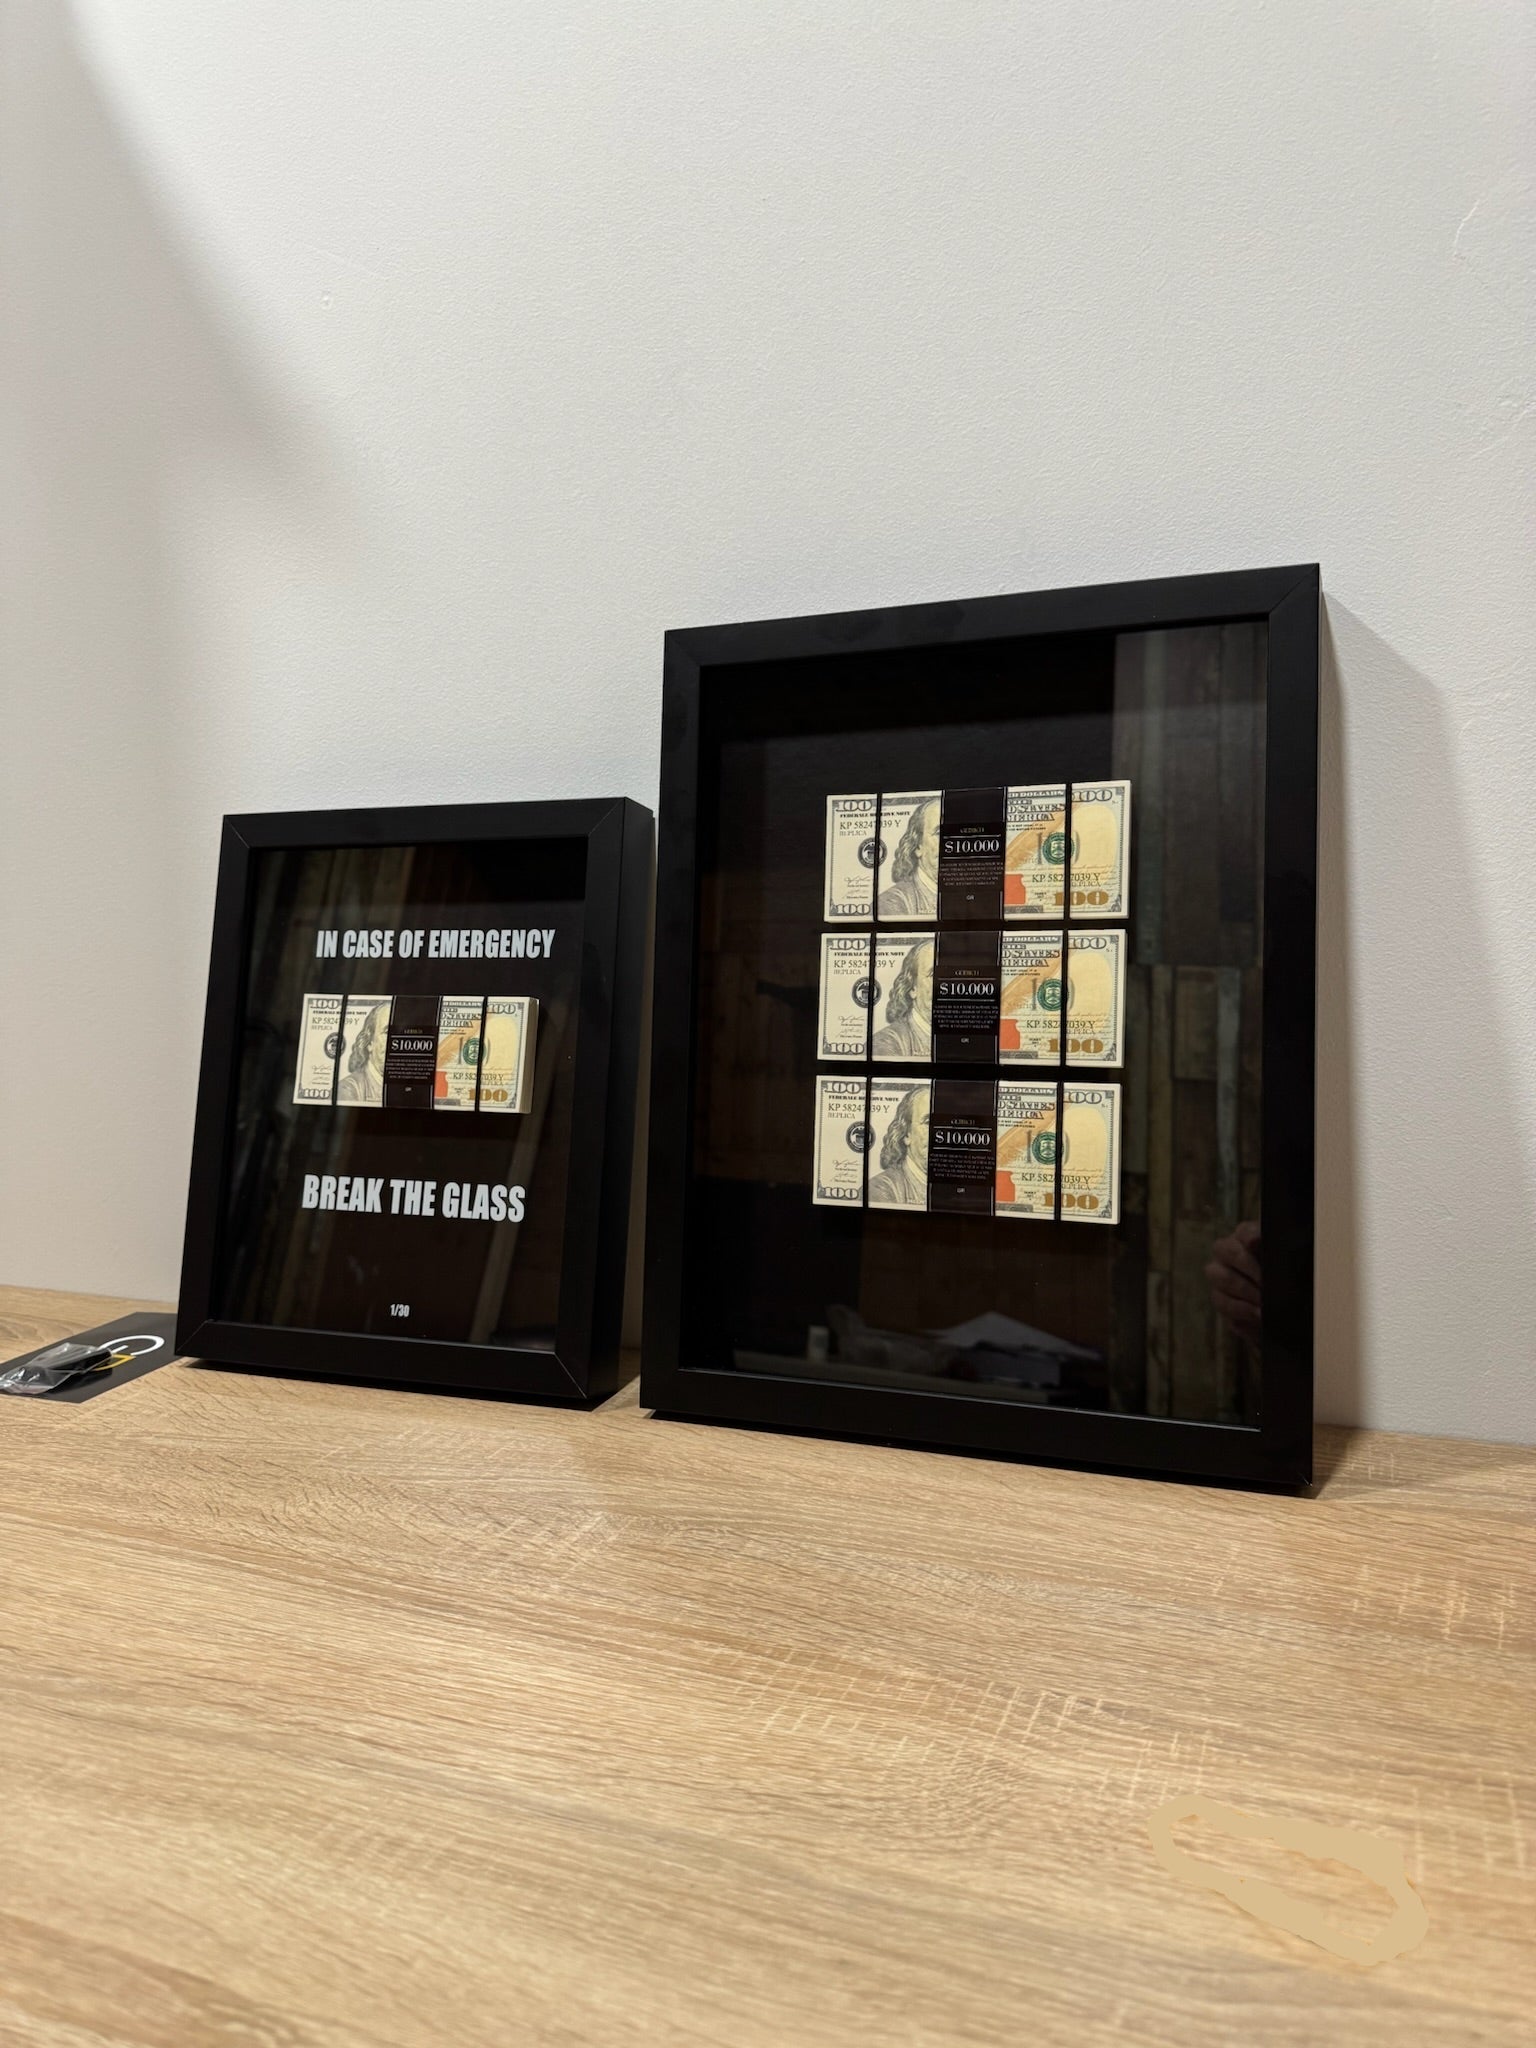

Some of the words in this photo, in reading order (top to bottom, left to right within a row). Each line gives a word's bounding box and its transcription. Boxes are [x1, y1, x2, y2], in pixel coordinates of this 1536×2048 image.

[1072, 789, 1112, 802] 100
[836, 799, 872, 812] 100
[1007, 813, 1055, 822] MERICA
[840, 821, 852, 829] KP
[854, 820, 892, 829] 582439
[895, 819, 901, 827] Y
[1032, 874, 1045, 882] KP
[1048, 873, 1091, 882] 5827039
[1093, 872, 1100, 881] Y
[1052, 890, 1109, 906] 100
[836, 903, 870, 915] 100
[316, 930, 338, 958] IN
[342, 930, 394, 958] CASE
[399, 930, 425, 958] OF
[428, 929, 556, 959] EMERGENCY
[830, 938, 866, 950] 100
[1068, 937, 1107, 949] 100
[834, 960, 846, 968] KP
[848, 960, 886, 968] 582439
[889, 960, 895, 968] Y
[310, 998, 339, 1009] 100
[1026, 1020, 1039, 1028] KP
[1043, 1020, 1086, 1028] 582039
[1088, 1020, 1095, 1028] Y
[829, 1042, 864, 1054] 100
[1047, 1039, 1103, 1053] 100
[303, 1088, 330, 1099] 100
[824, 1081, 861, 1094] 100
[468, 1088, 508, 1102] 100
[828, 1103, 840, 1111] KP
[842, 1103, 881, 1112] 5824739
[883, 1105, 889, 1113] Y
[1021, 1173, 1034, 1181] KP
[1037, 1173, 1080, 1184] 582039
[1083, 1176, 1090, 1184] Y
[302, 1174, 385, 1213] BREAK
[390, 1179, 437, 1217] THE
[442, 1182, 526, 1223] GLASS
[824, 1187, 858, 1200] 100
[1042, 1192, 1099, 1210] 100
[390, 1304, 410, 1318] 1/30
